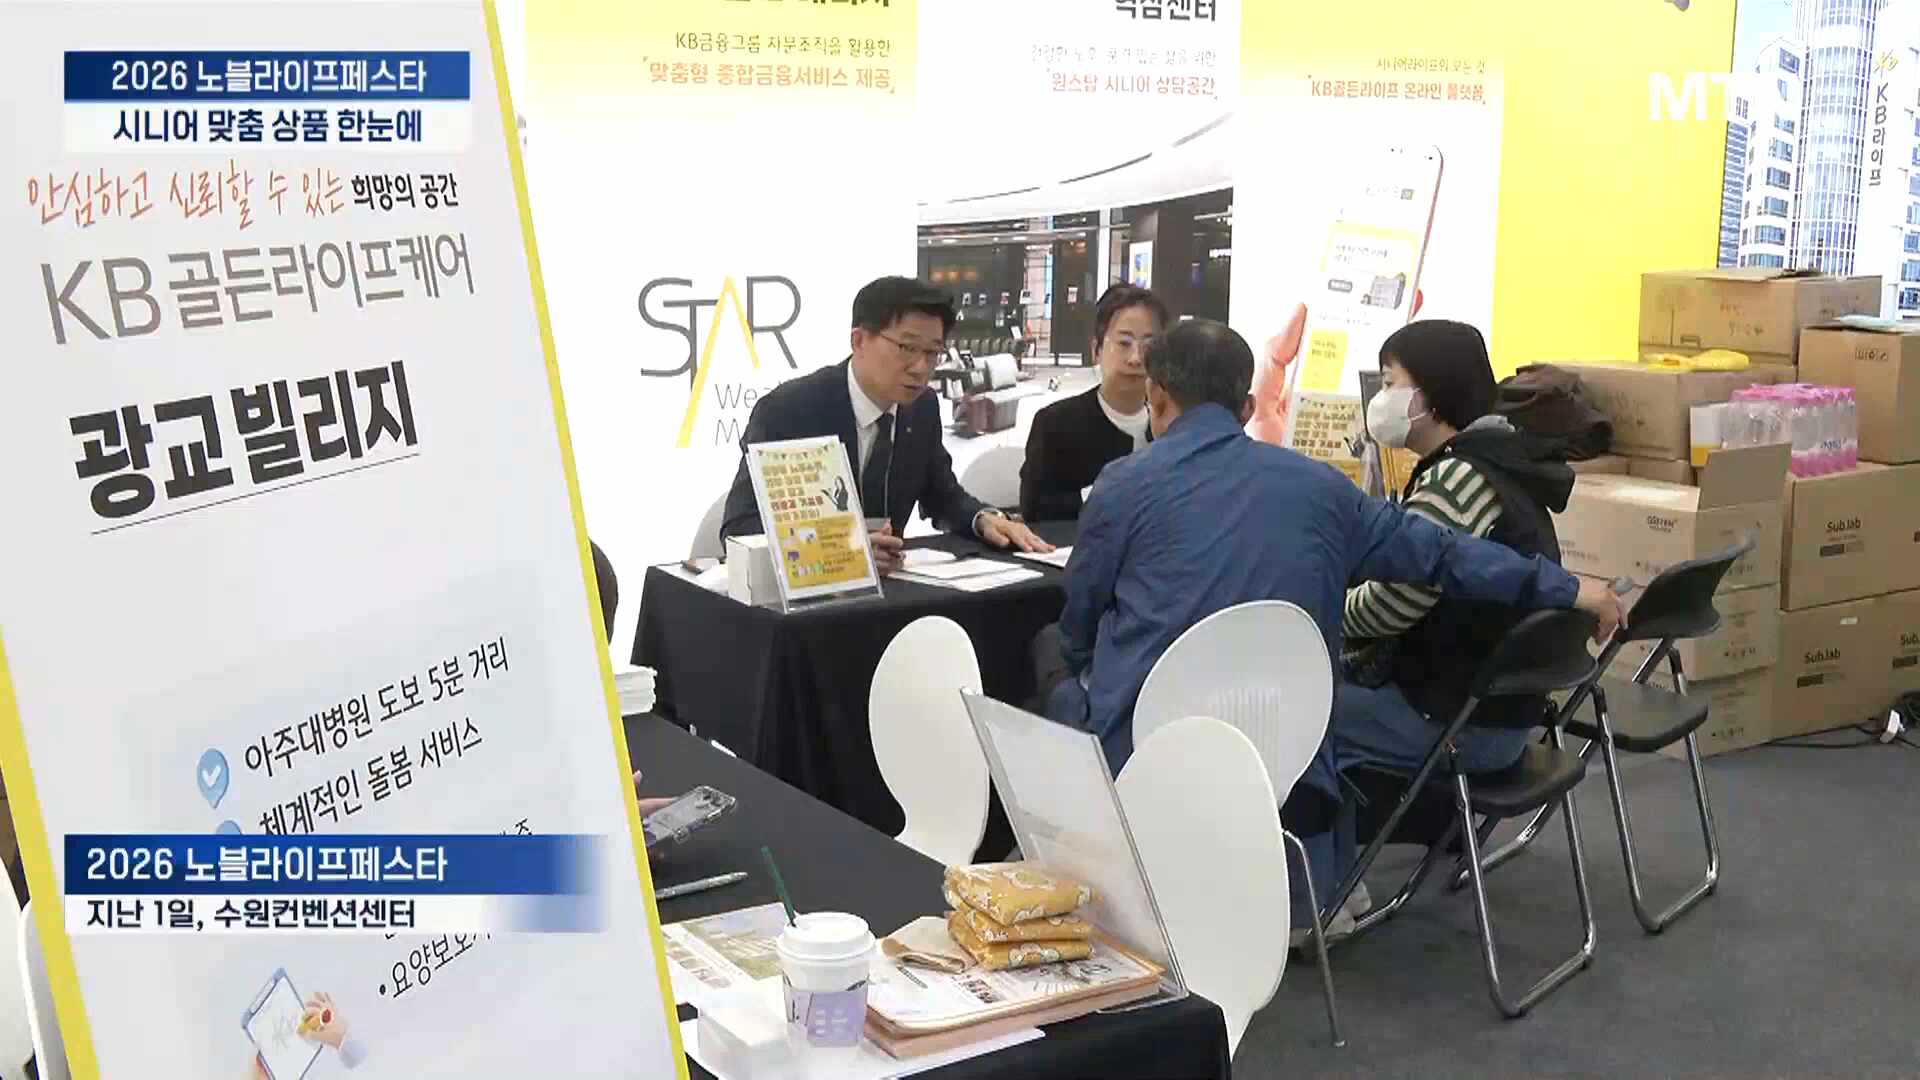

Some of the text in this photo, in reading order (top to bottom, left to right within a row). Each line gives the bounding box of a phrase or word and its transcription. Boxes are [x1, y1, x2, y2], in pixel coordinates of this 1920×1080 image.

[675, 32, 761, 53] KB금융그룹
[716, 63, 848, 86] 종합금융서비스
[1105, 75, 1150, 93] 시니어
[1404, 82, 1442, 99] 온라인
[27, 159, 459, 230] 안심하고 신뢰할 수 있는 희망의 공간
[638, 275, 802, 449] STAR
[244, 636, 511, 778] 아주대병원 도보 5분 거리
[259, 716, 483, 834] 체계적인 돌봄 서비스
